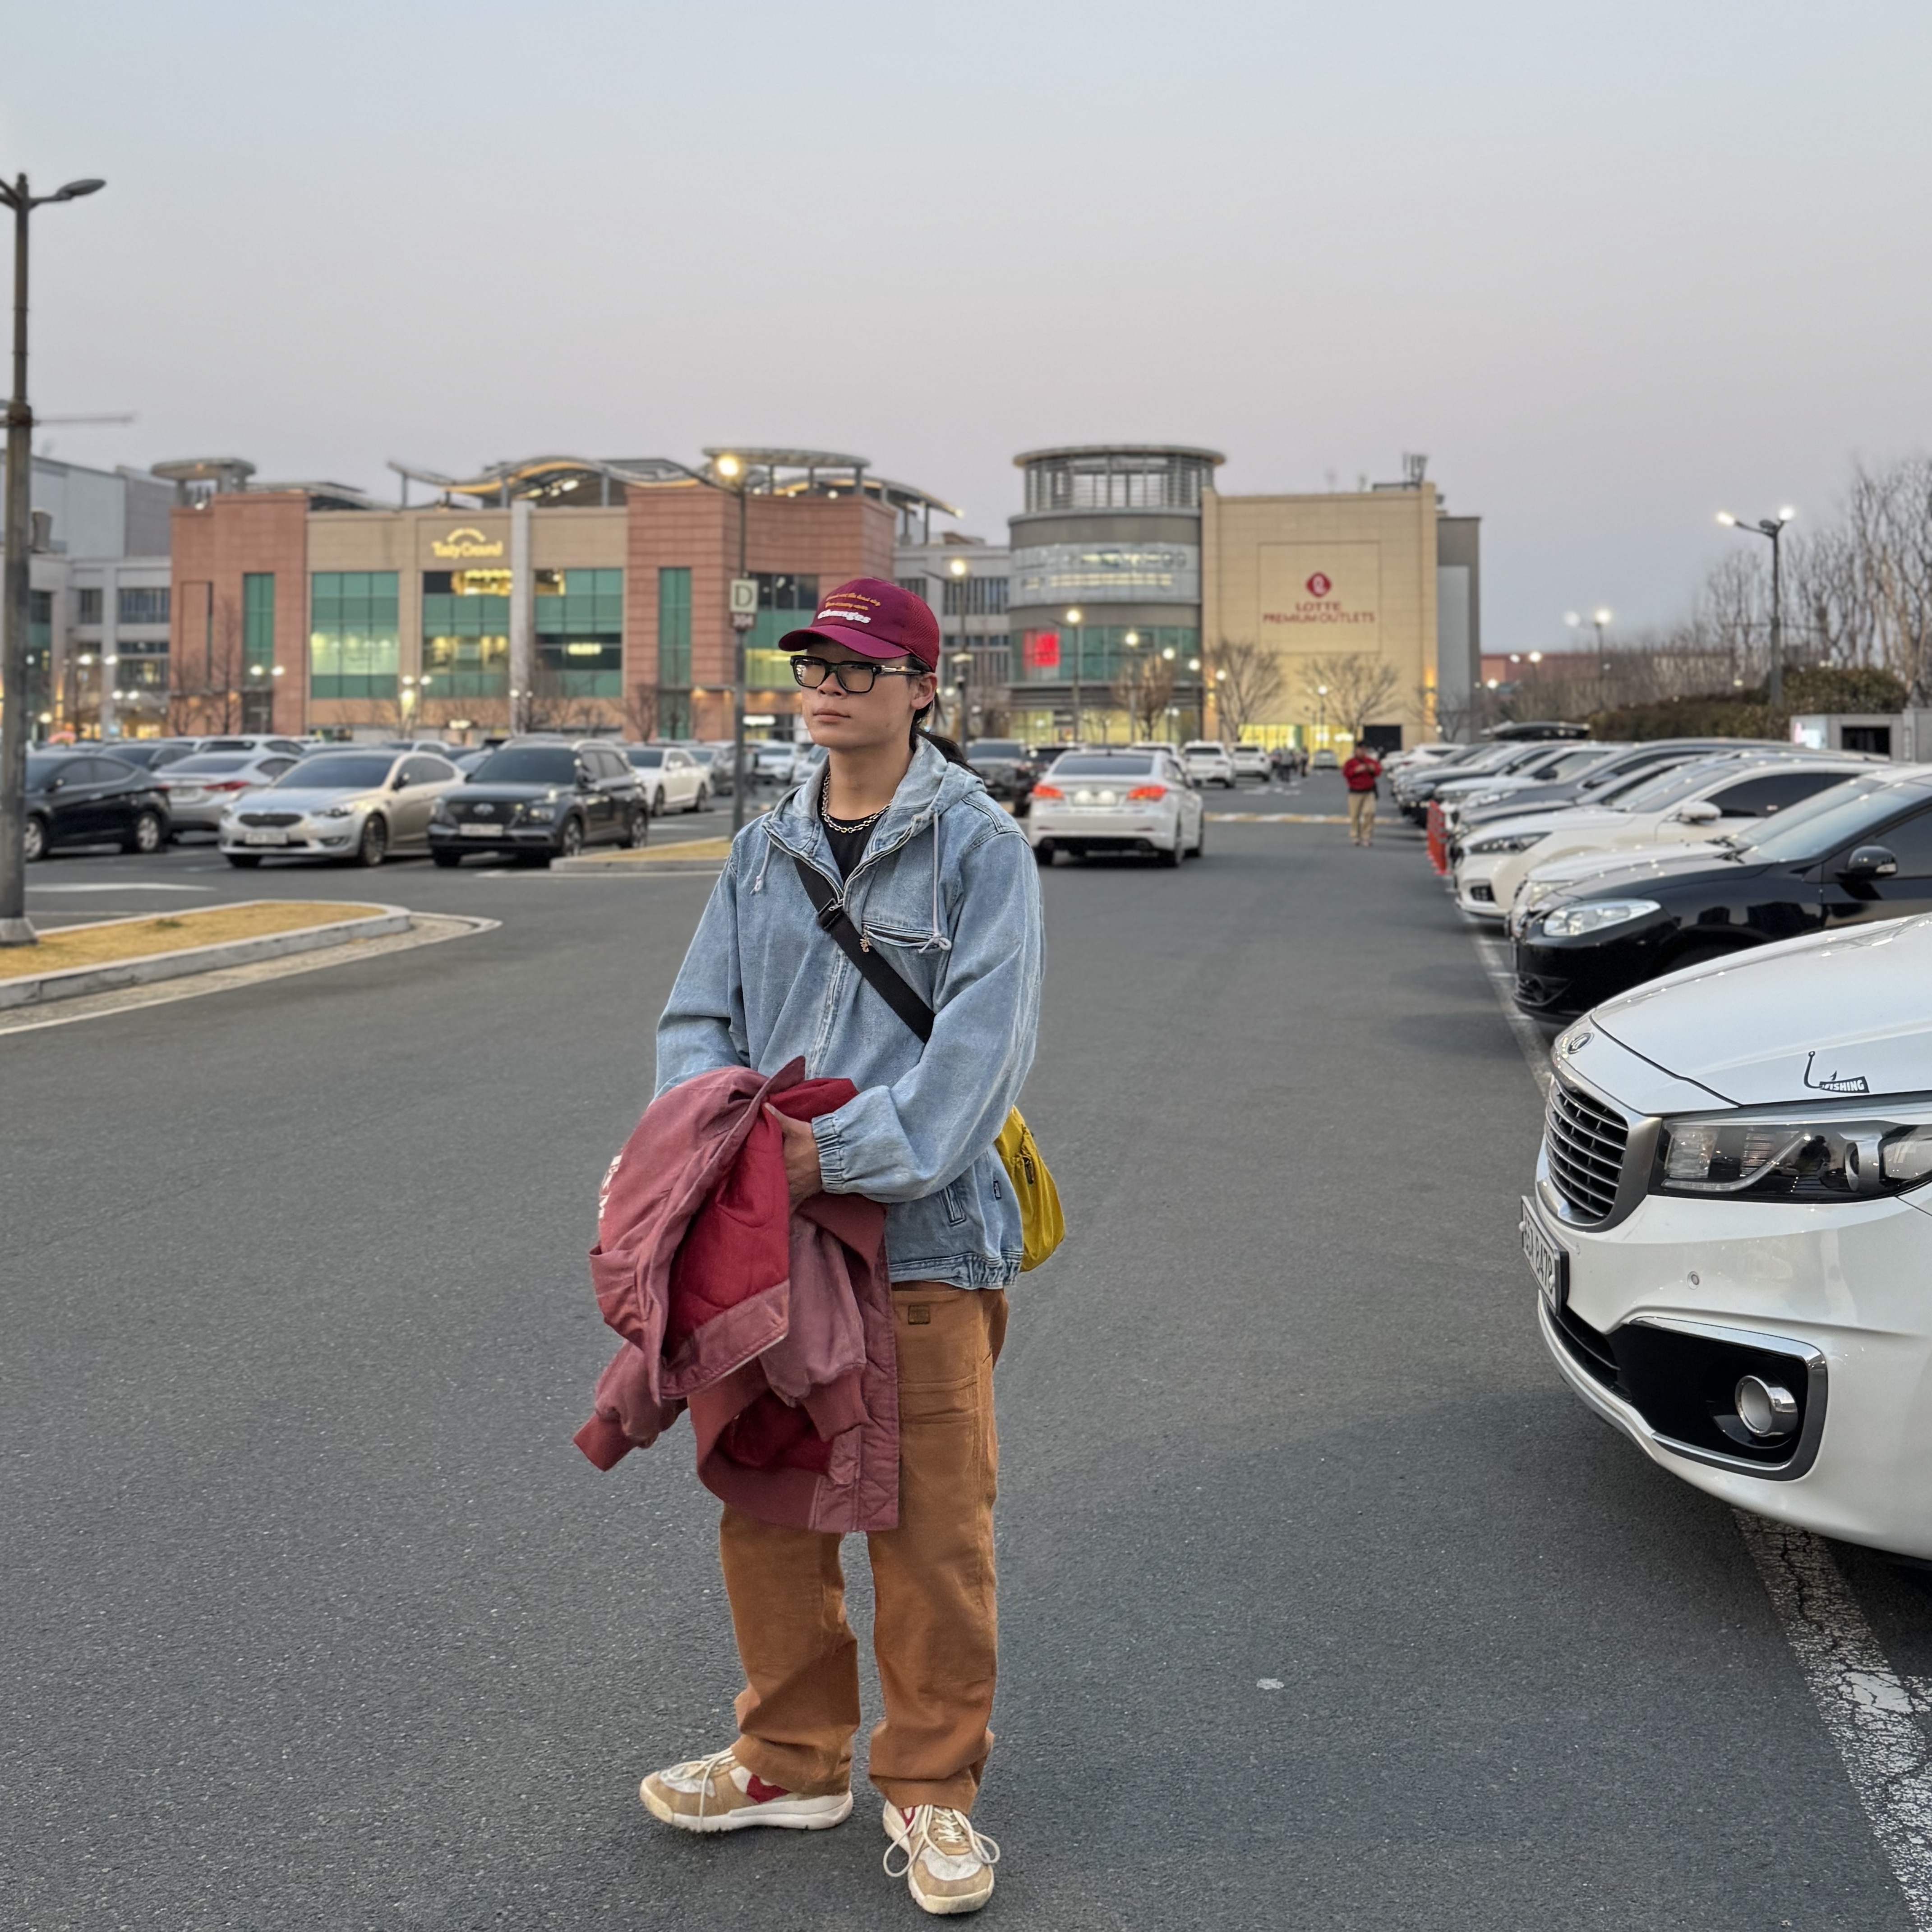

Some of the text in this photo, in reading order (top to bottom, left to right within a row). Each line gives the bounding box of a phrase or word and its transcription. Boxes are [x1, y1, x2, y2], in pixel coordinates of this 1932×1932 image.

[735, 584, 753, 607] D
[1295, 602, 1340, 611] LOTTE
[1263, 612, 1375, 623] PREMIUM OUTLETS
